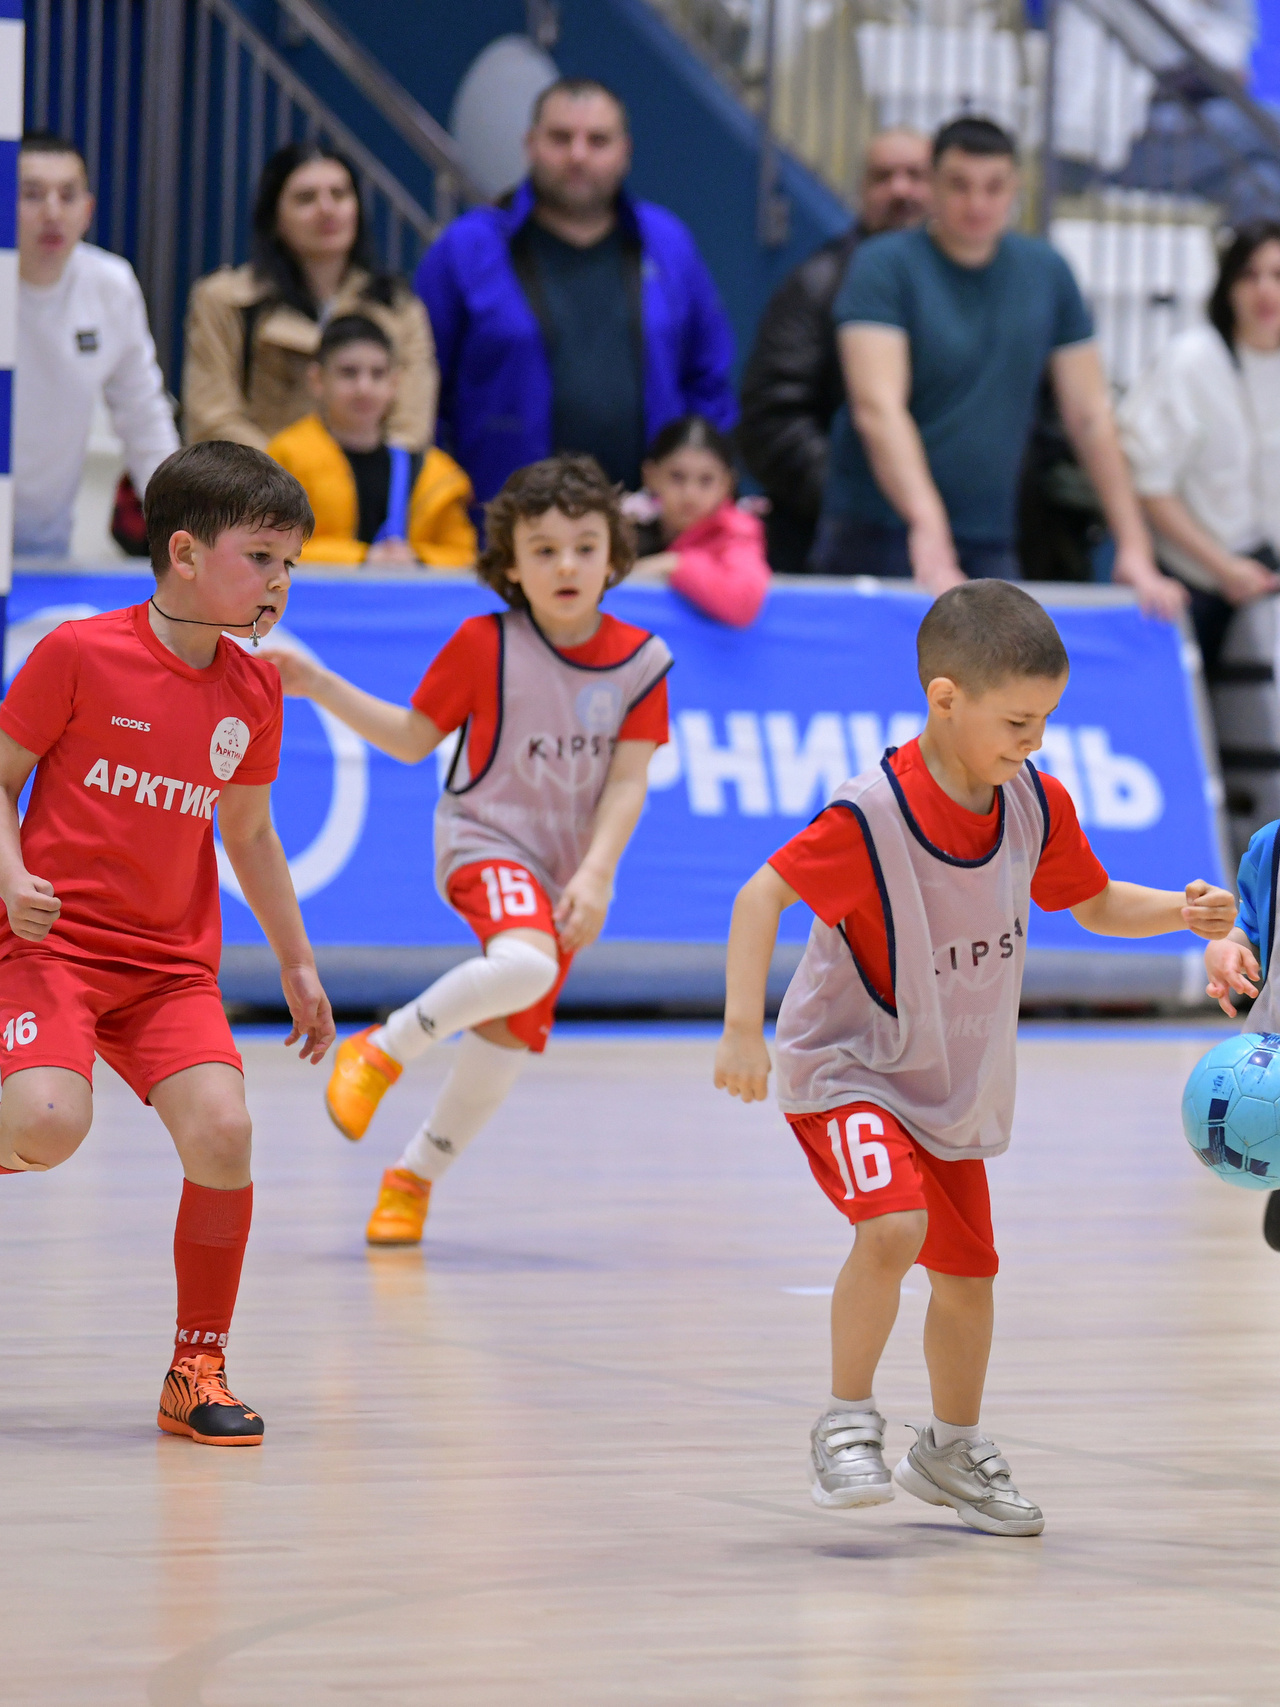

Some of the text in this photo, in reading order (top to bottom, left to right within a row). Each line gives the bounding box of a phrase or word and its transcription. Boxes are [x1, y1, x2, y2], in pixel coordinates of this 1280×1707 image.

[481, 866, 537, 922] 15
[3, 1011, 38, 1052] 16
[826, 1112, 892, 1200] 16
[178, 1328, 229, 1347] KIPS
